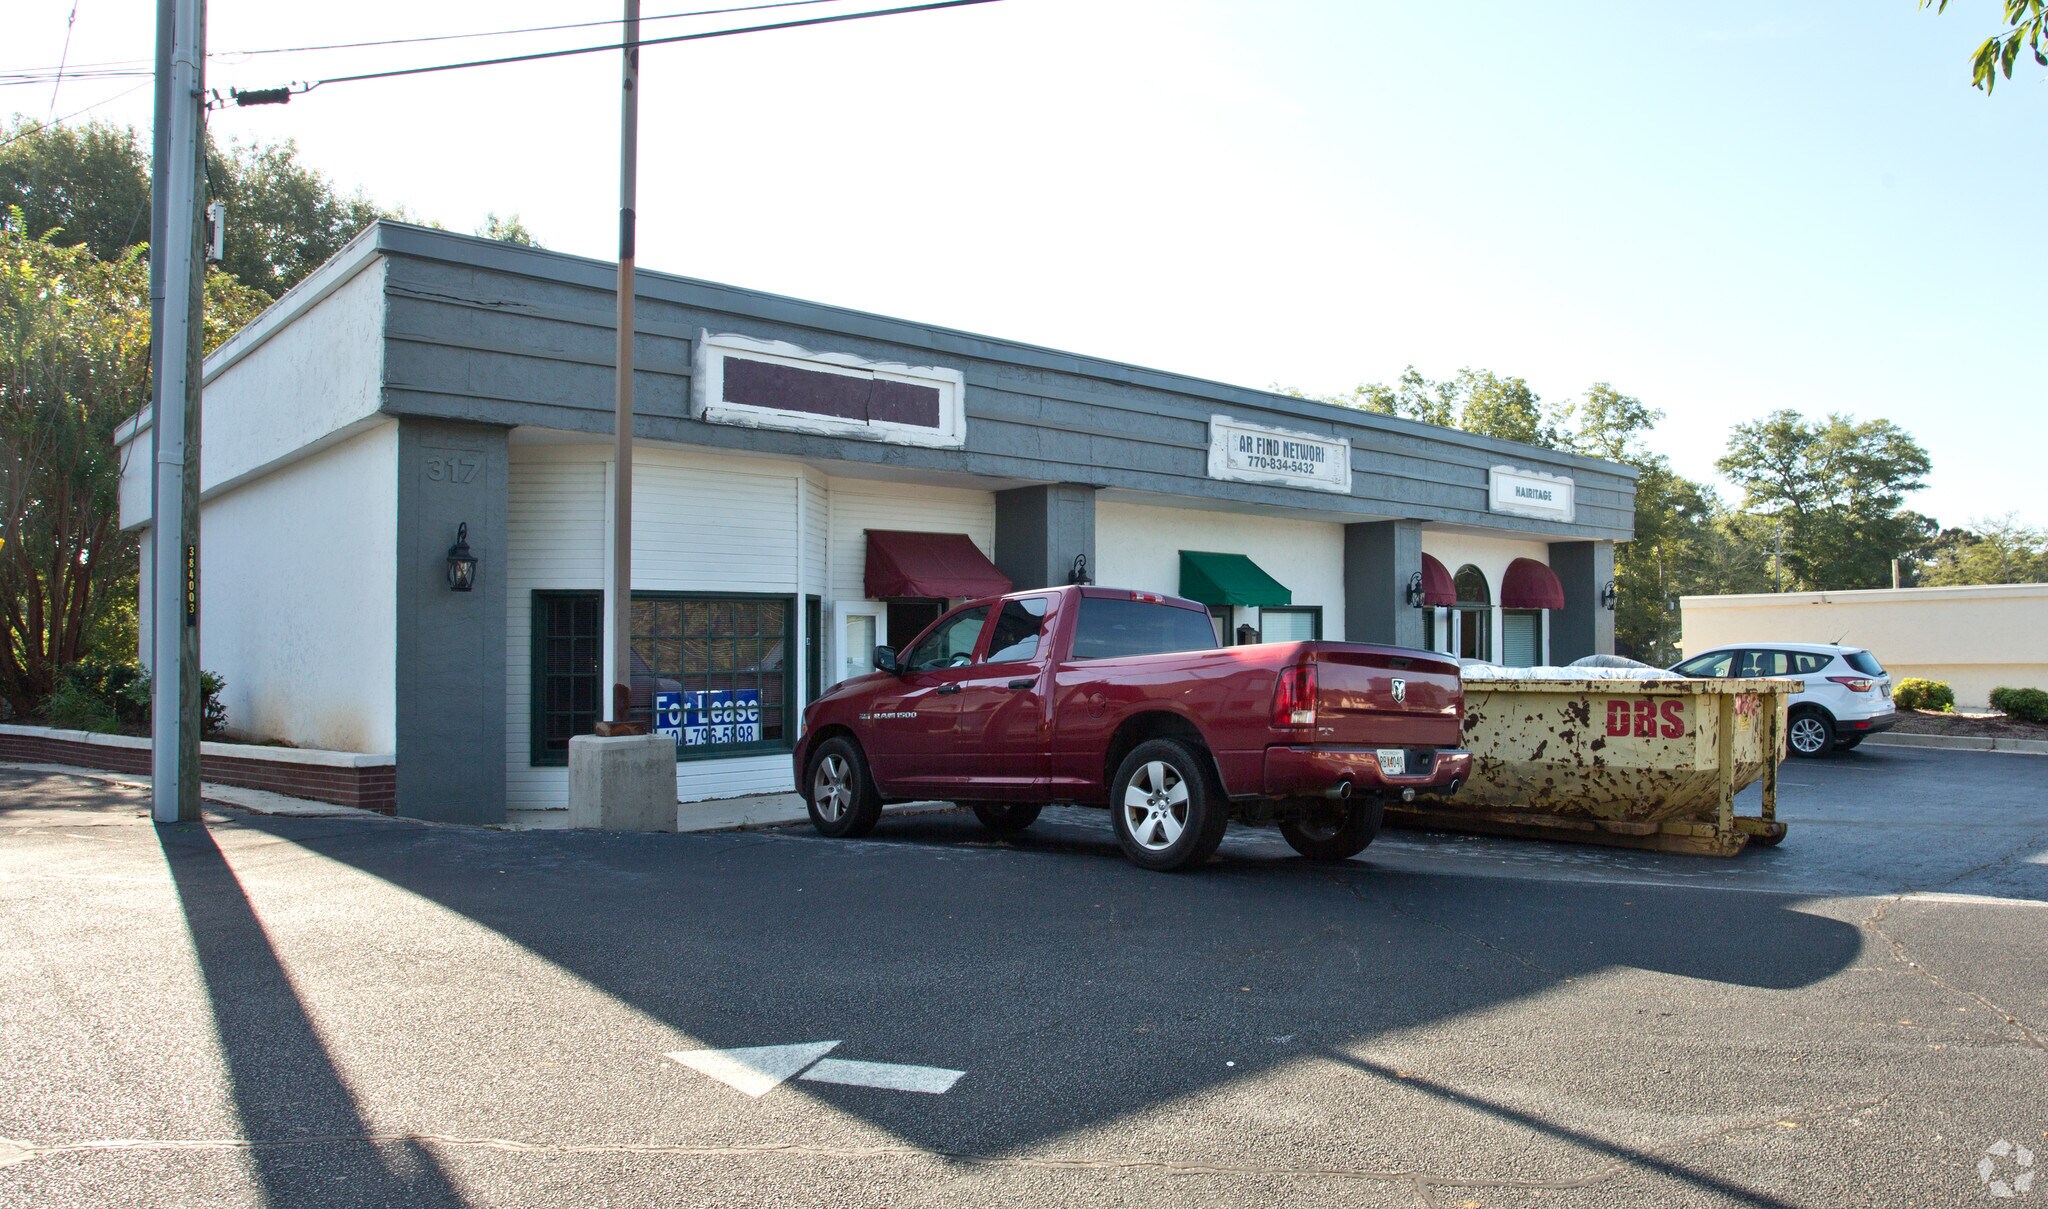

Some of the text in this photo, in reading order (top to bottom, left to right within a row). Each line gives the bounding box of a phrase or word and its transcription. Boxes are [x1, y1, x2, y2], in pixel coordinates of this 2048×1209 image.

[1256, 437, 1280, 459] FIND
[426, 457, 481, 484] 317
[1247, 455, 1315, 475] 770-834-5432
[1515, 486, 1552, 501] HAIRITAGE
[187, 546, 195, 613] 384003
[656, 694, 759, 726] For Lease
[896, 711, 917, 719] 1500
